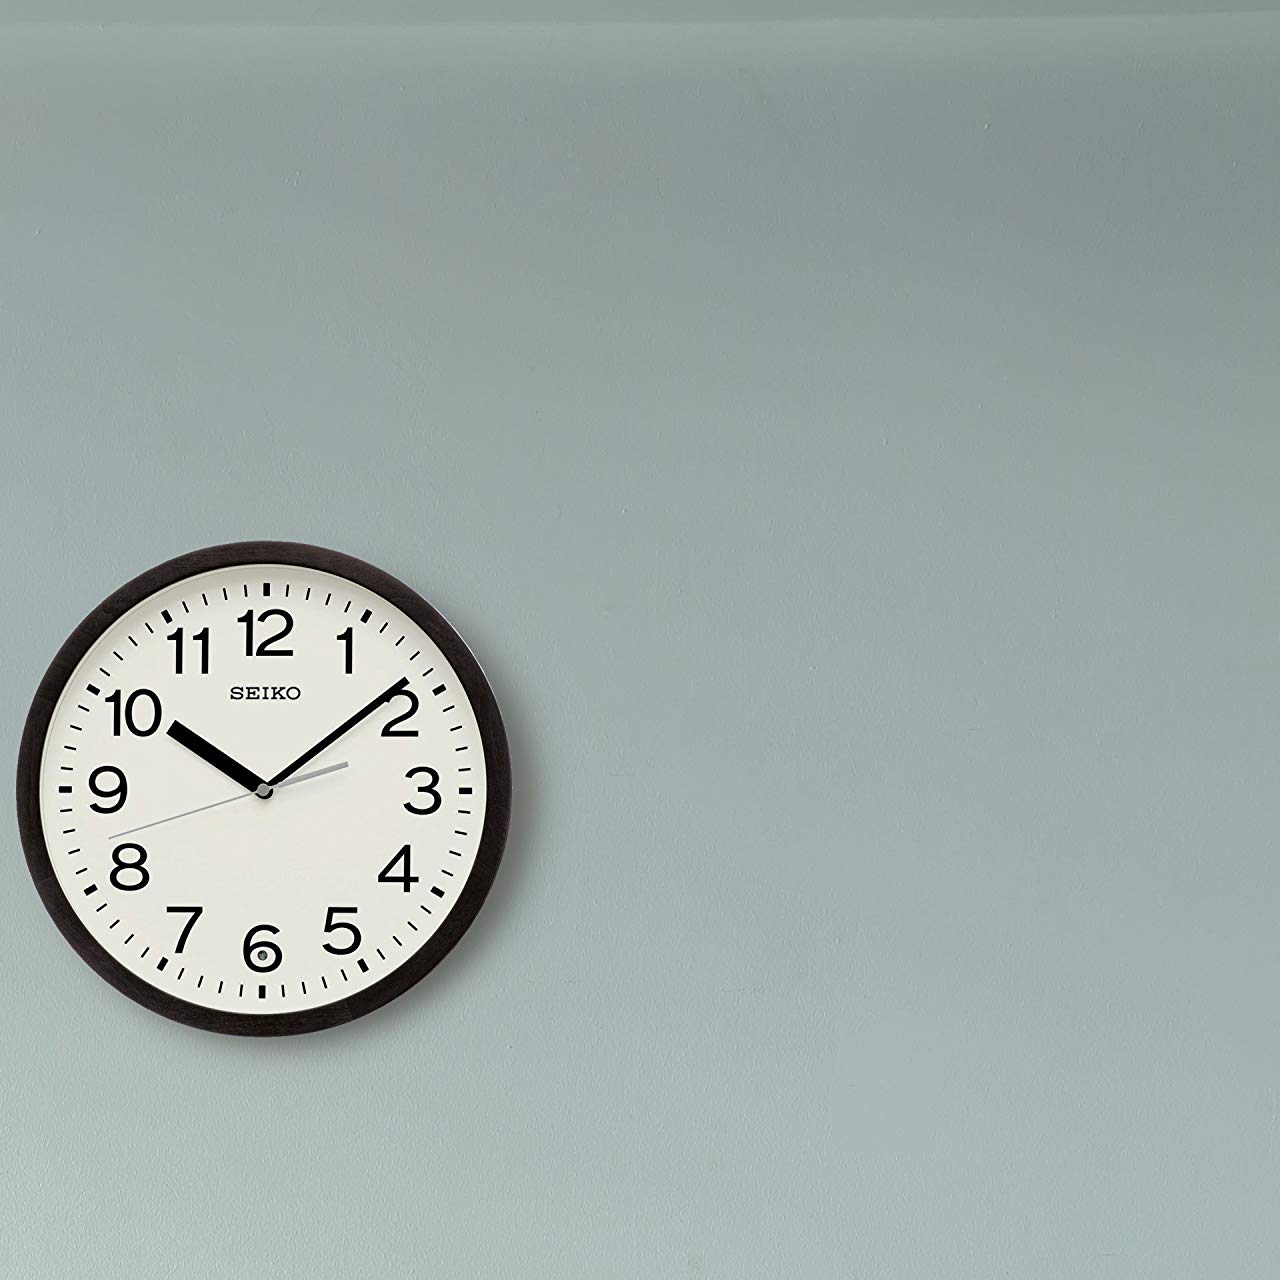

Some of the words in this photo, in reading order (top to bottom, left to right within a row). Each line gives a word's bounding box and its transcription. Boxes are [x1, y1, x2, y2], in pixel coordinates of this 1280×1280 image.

[166, 627, 210, 675] 11
[237, 608, 294, 657] 12
[336, 627, 354, 675] 1
[104, 688, 163, 738] 10
[230, 686, 301, 701] SEIKO
[380, 688, 420, 738] 2
[88, 765, 128, 815] 9
[403, 766, 442, 816] 3
[109, 842, 150, 892] 8
[377, 844, 420, 893] 4
[166, 906, 203, 954] 7
[242, 924, 283, 974] 6
[322, 906, 362, 956] 5
